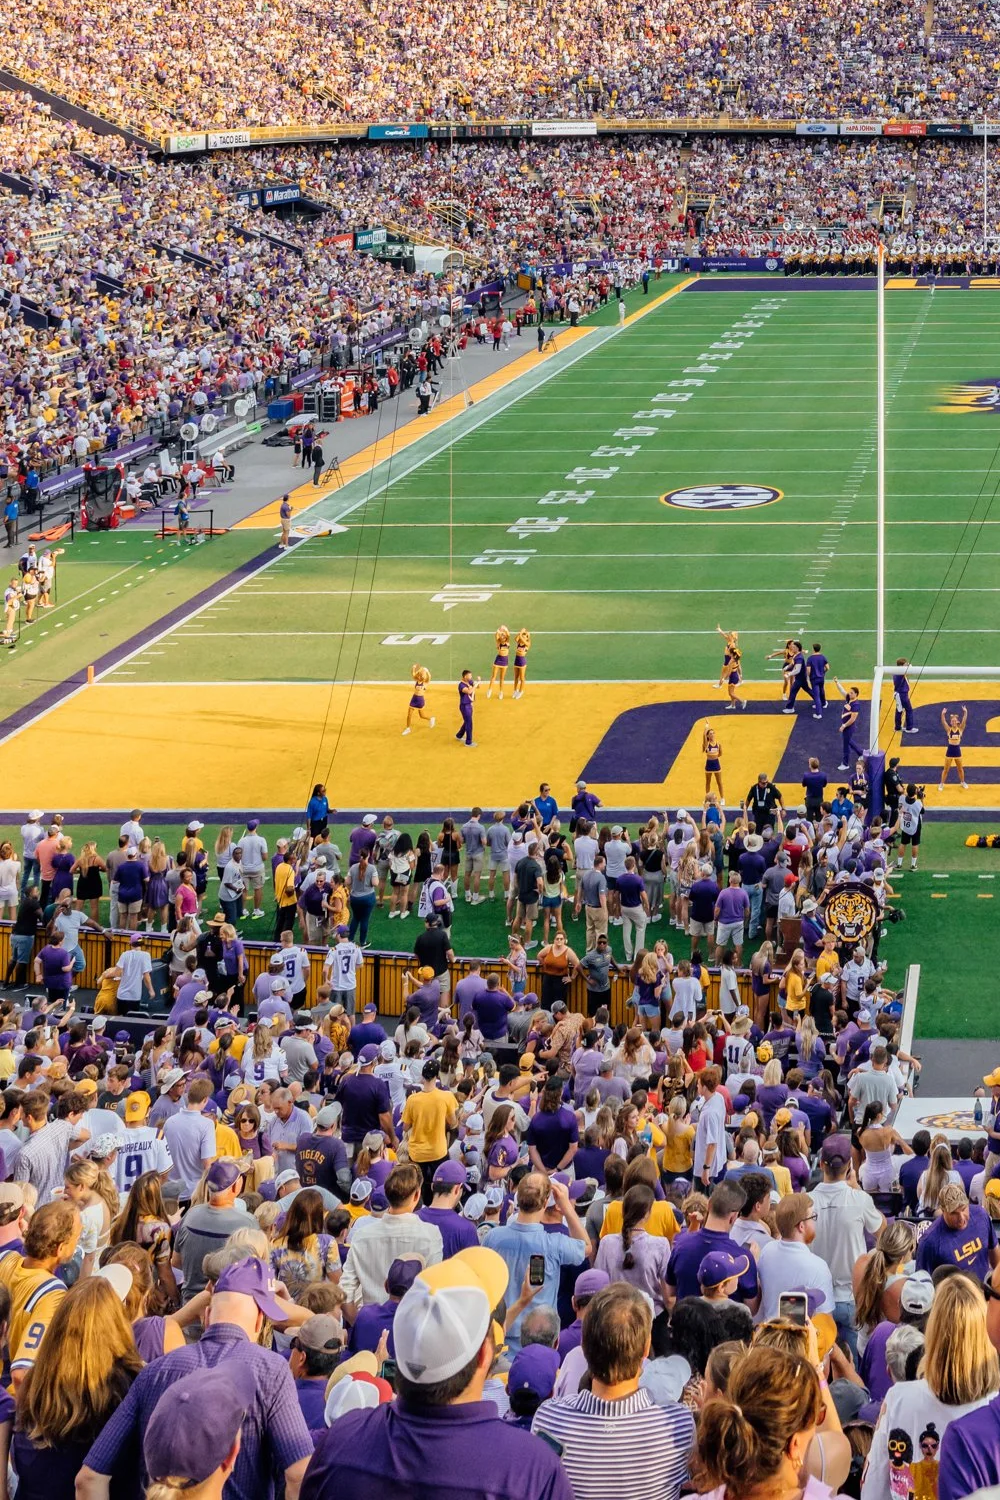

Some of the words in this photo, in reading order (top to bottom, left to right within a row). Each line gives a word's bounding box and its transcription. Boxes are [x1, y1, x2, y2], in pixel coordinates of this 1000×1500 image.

[219, 136, 234, 145] TACO
[235, 135, 248, 144] BELL
[469, 127, 494, 137] 14:51
[274, 189, 300, 202] Marathon
[565, 466, 620, 479] 30
[537, 491, 596, 505] 25
[506, 517, 569, 533] 20
[470, 549, 538, 565] 15
[429, 584, 502, 602] 10
[380, 634, 451, 645] 5
[286, 960, 296, 977] 9
[342, 955, 352, 974] 3
[858, 976, 865, 991] 9
[728, 1044, 740, 1064] 11
[254, 1061, 265, 1081] 9
[299, 1149, 326, 1165] TIGERS
[125, 1154, 143, 1192] 9
[302, 1176, 317, 1185] LSU
[954, 1237, 983, 1262] LSU
[24, 1322, 46, 1350] 9
